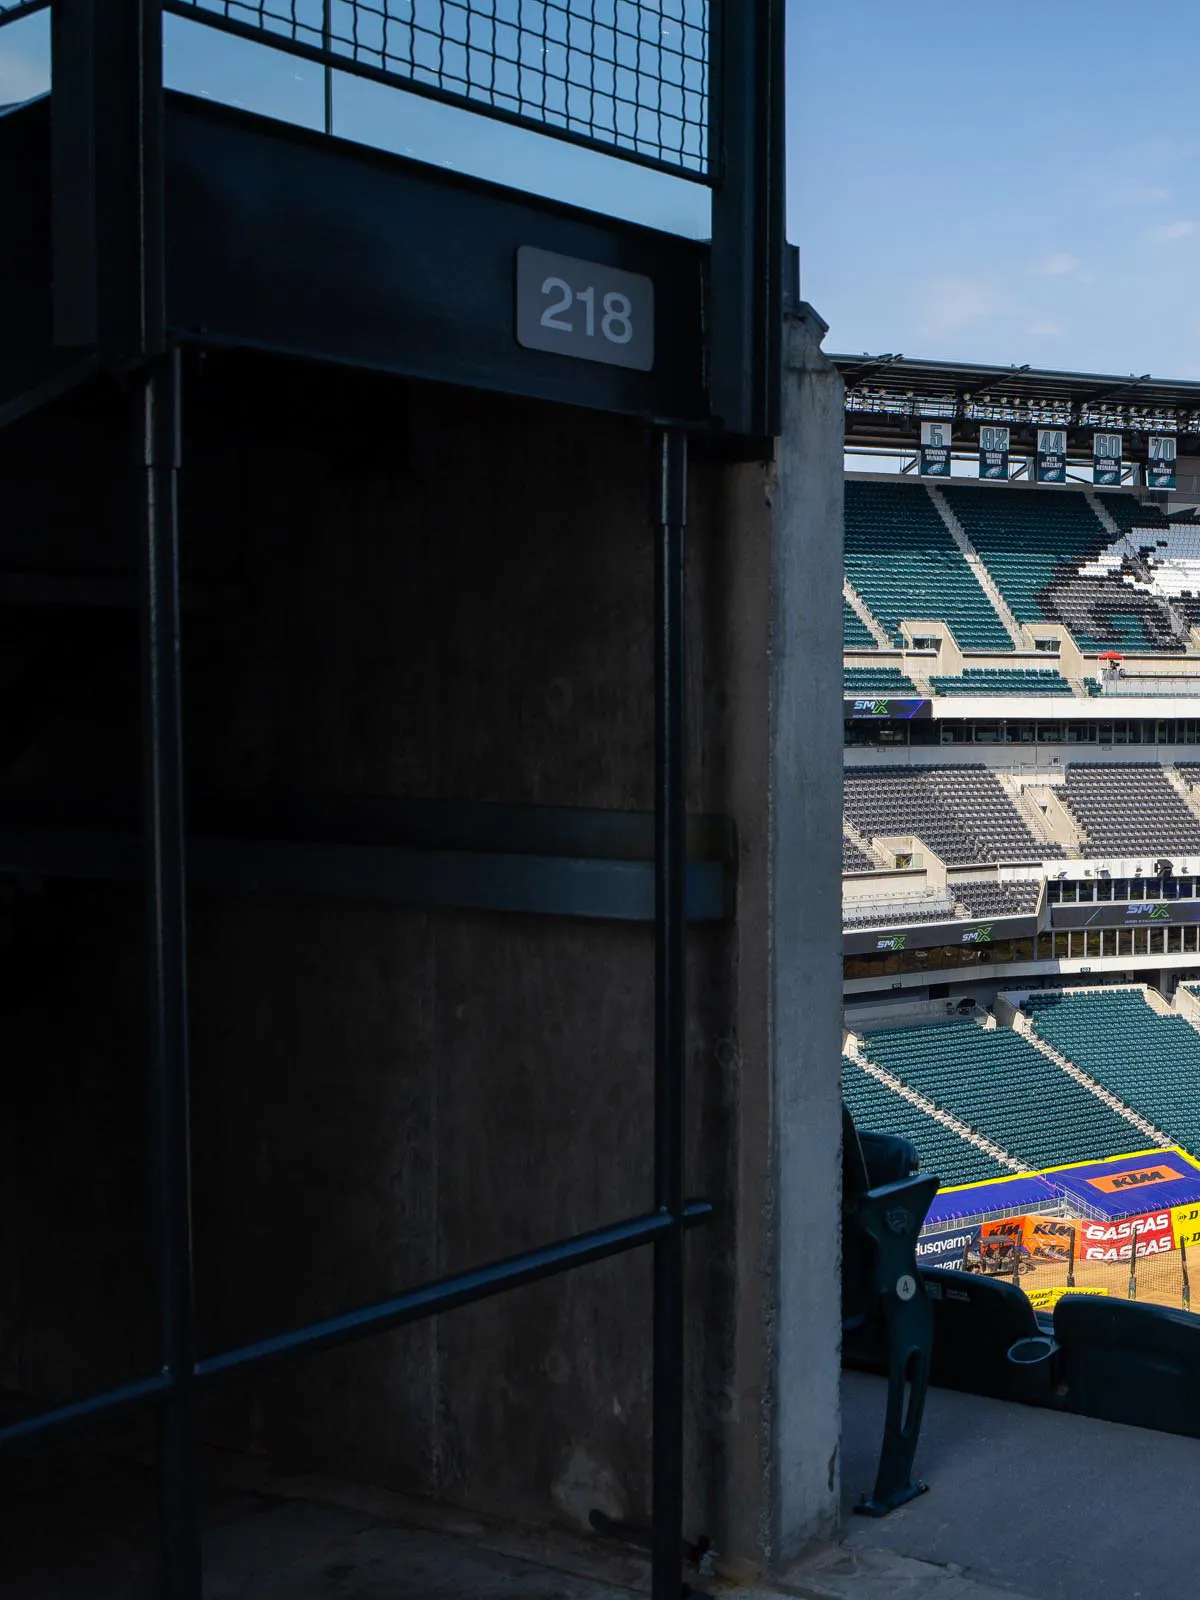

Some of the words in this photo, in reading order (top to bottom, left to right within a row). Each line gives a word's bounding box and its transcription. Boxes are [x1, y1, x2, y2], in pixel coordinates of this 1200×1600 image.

[540, 276, 633, 344] 218
[930, 424, 942, 448] 5
[982, 428, 1007, 451] 92
[1040, 432, 1063, 455] 44
[1096, 435, 1119, 458] 60
[1152, 438, 1175, 461] 70
[854, 699, 888, 714] SMX
[1126, 903, 1170, 917] SMX
[876, 937, 905, 950] SMX
[961, 927, 992, 942] SMX
[1111, 1171, 1165, 1188] KTM
[989, 1222, 1021, 1237] KTM
[1033, 1222, 1077, 1236] KTM
[1085, 1213, 1170, 1241] GASGAS
[1085, 1236, 1172, 1260] GASGAS
[902, 1280, 909, 1293] 4
